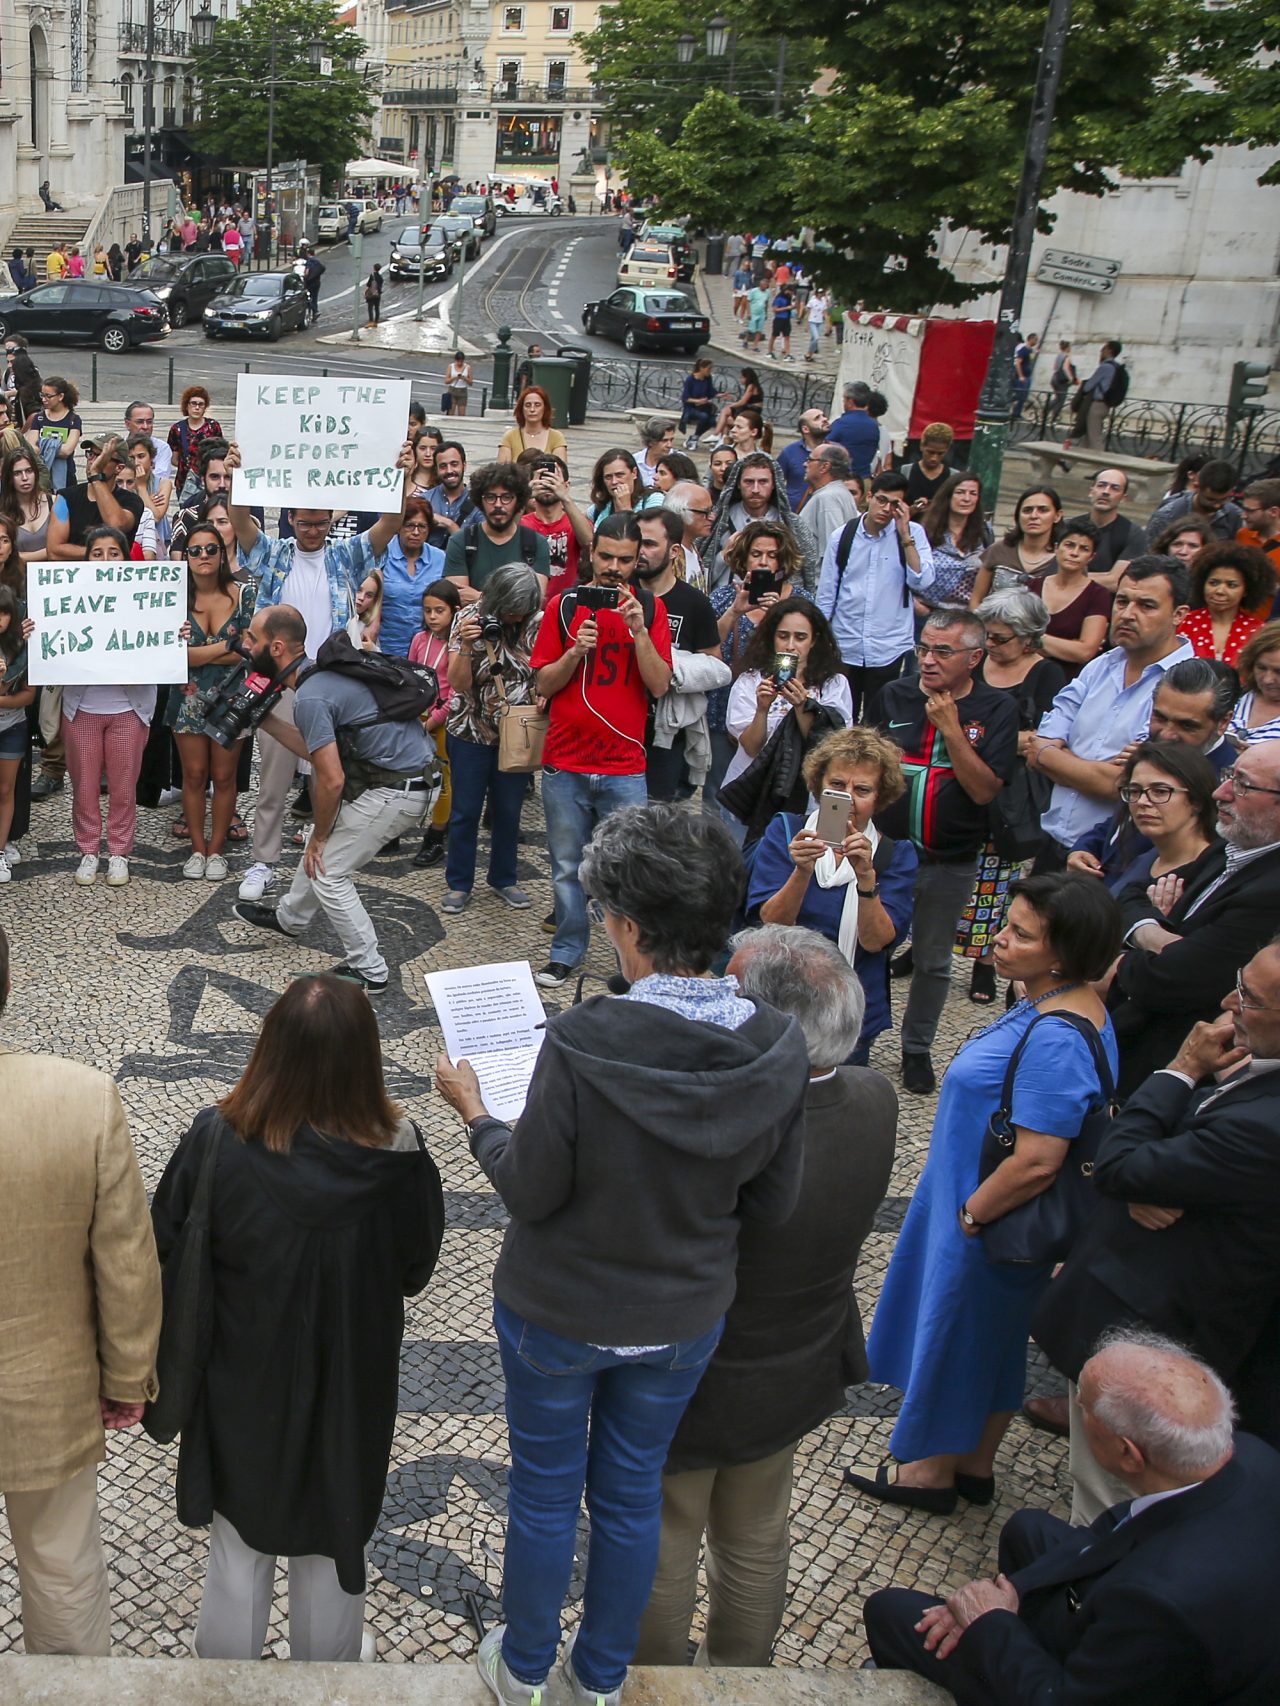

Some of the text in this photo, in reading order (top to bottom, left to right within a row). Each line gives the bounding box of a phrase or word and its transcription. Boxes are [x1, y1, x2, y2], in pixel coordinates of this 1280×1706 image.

[257, 385, 387, 405] KEEP THE
[270, 443, 359, 460] DEPORT
[244, 467, 293, 489] THE
[37, 567, 80, 586] HEY
[43, 590, 177, 618] LEAVE THE
